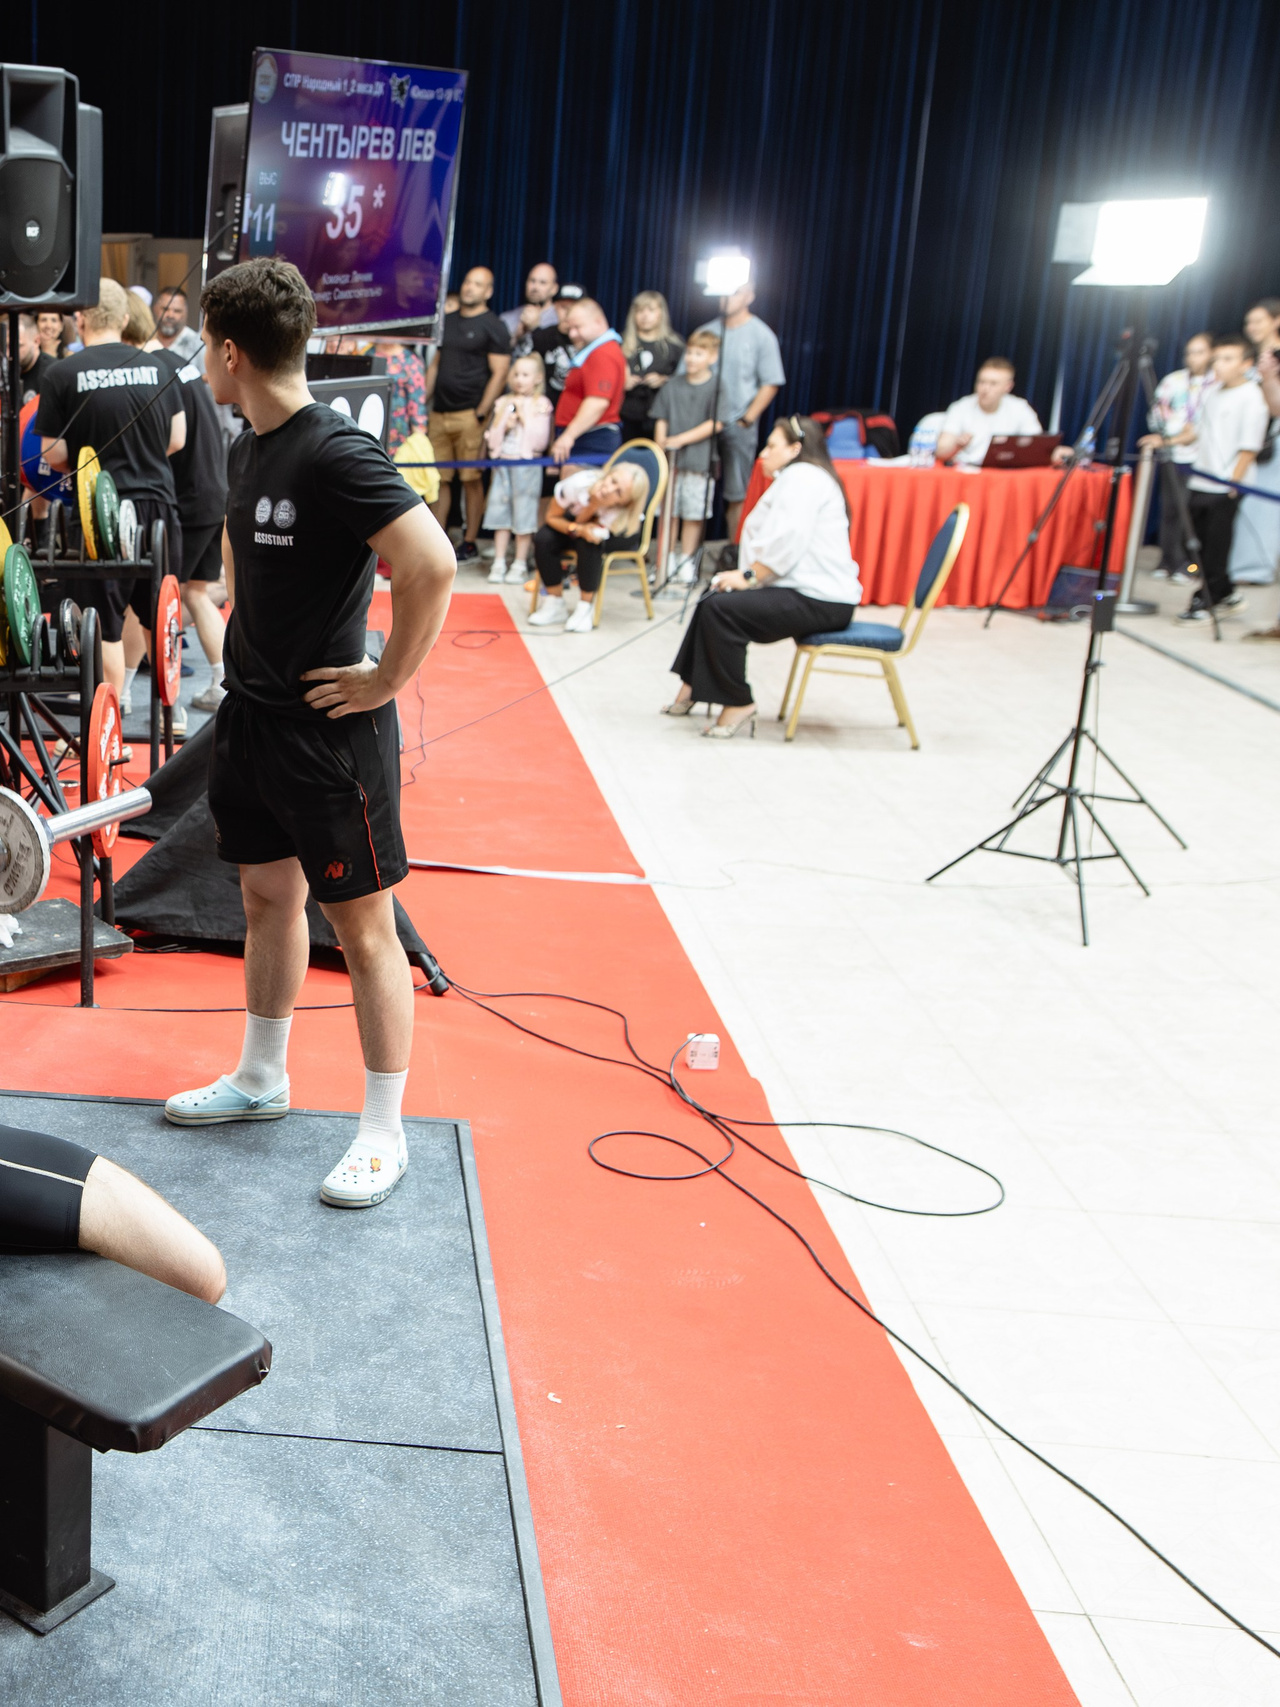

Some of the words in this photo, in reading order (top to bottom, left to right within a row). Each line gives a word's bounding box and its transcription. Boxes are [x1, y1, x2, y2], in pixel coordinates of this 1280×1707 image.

[281, 120, 395, 161] ЧЕНТЫРЕВ
[397, 128, 437, 162] ЛЕВ
[77, 365, 158, 393] ASSISTANT
[254, 531, 294, 546] ASSISTANT
